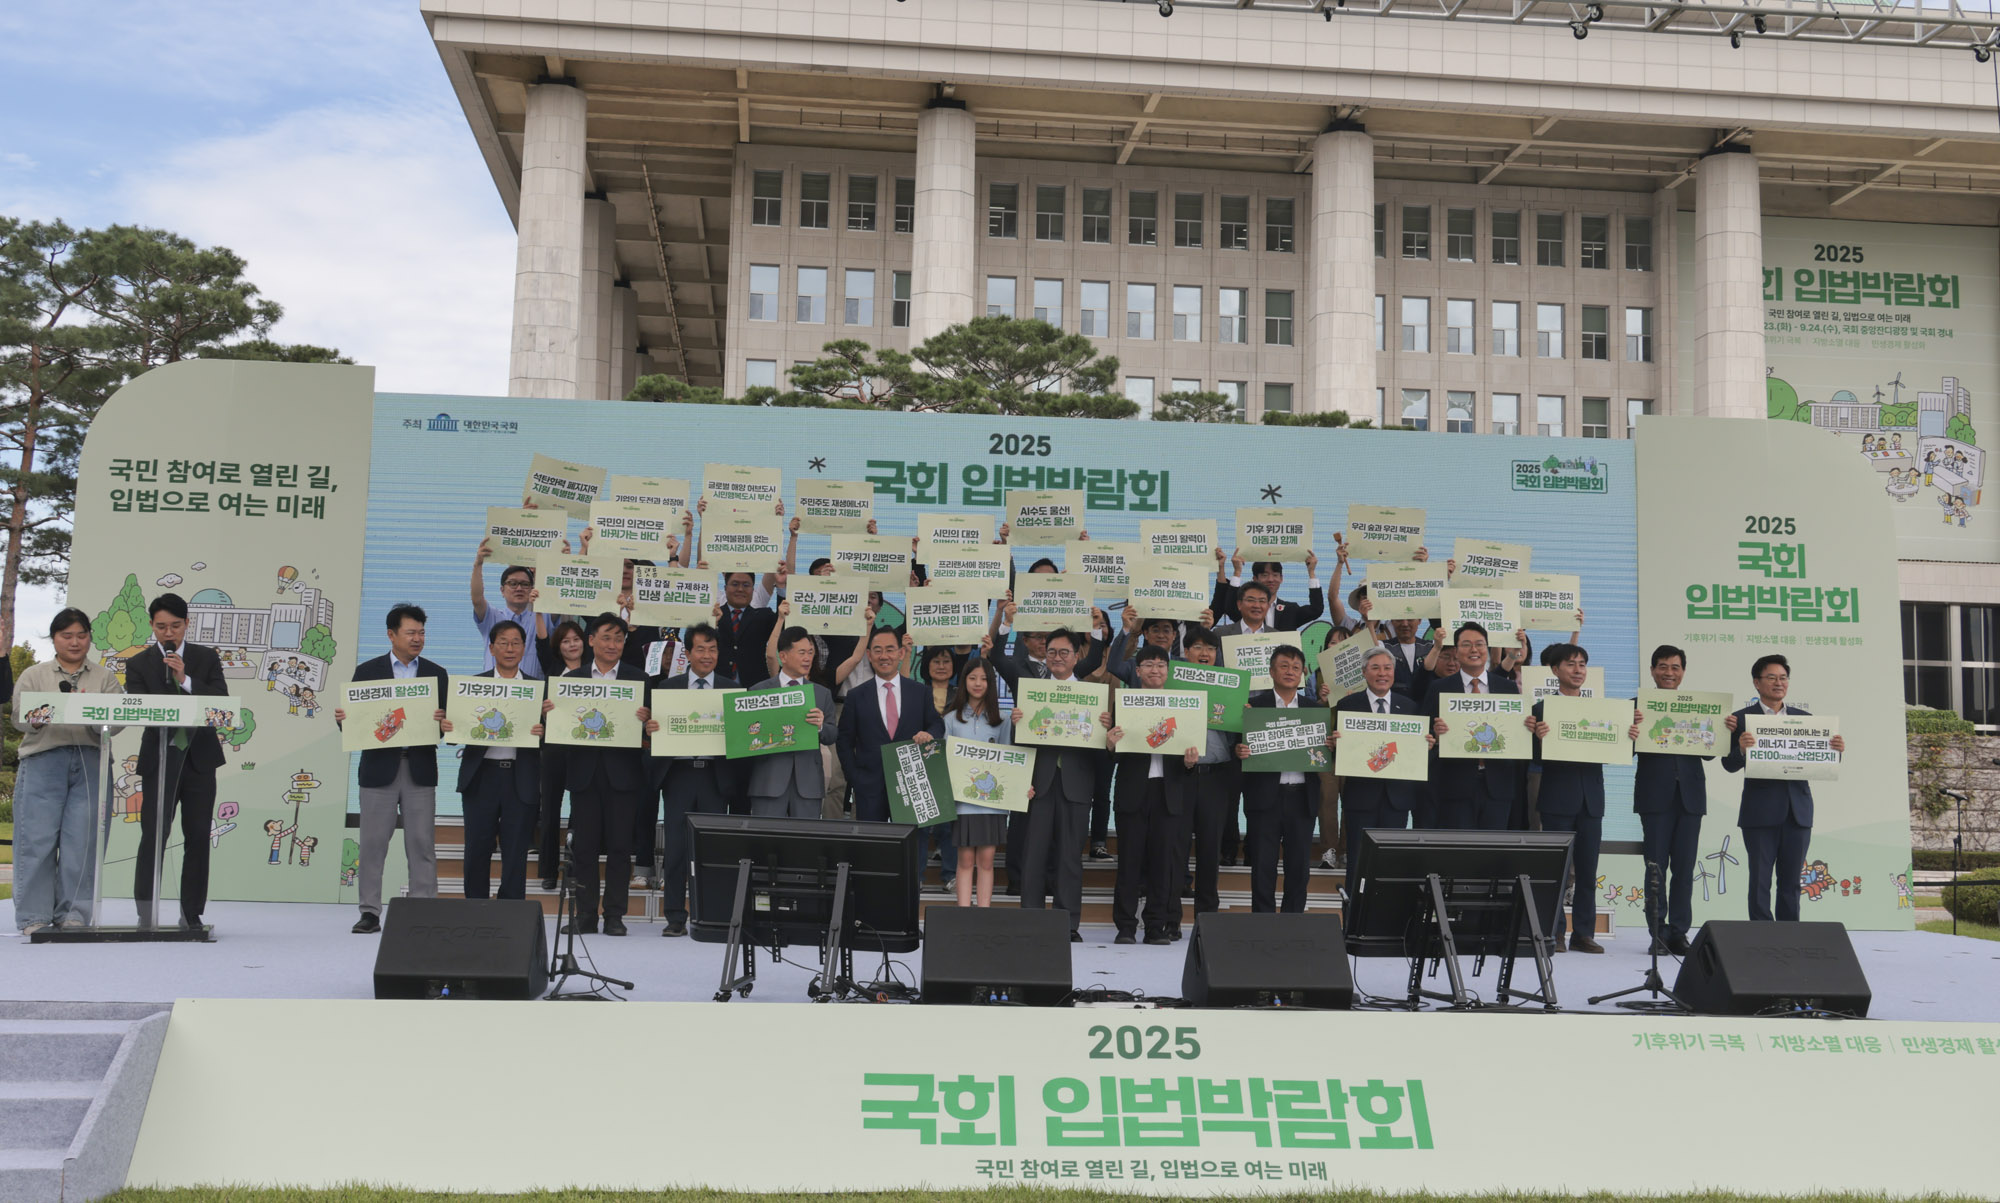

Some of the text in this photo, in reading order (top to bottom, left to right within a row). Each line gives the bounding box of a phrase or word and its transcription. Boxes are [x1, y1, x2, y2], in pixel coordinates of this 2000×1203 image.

[1814, 244, 1864, 263] 2025
[1793, 268, 1960, 309] 입법박람회
[1768, 308, 1911, 324] 국민 참여로 열린 길, 입법으로 여는 미래
[1842, 324, 1859, 336] 국회
[1860, 325, 1908, 337] 중앙잔디광장
[1920, 327, 1936, 338] 국회
[402, 419, 518, 431] 주최 대한민국국회
[988, 433, 1052, 457] 2025
[1516, 464, 1541, 474] 2025
[109, 458, 338, 493] 국민 참여로 열린 길,
[532, 482, 550, 494] 지원
[533, 472, 598, 494] 석탄화력 폐지지역
[864, 459, 948, 505] 국회
[1516, 474, 1604, 490] 국회 입법박람회
[109, 488, 326, 520] 입법으로 여는 미래
[800, 498, 869, 509] 주민주도 재생에너지
[1020, 506, 1071, 516] AI수도 울산!
[597, 517, 664, 530] 국민의 의견으로
[1016, 516, 1075, 526] 산업수도 울산!
[1745, 515, 1796, 535] 2025
[1246, 525, 1303, 534] 기후 위기 대응
[1352, 522, 1397, 533] 우리 숲과 우리
[601, 529, 659, 541] 바꿔가는 바다
[933, 529, 979, 539] 시민의 대화
[1151, 534, 1178, 544] 산촌의
[1252, 535, 1298, 545] 아동과 함께
[1363, 532, 1407, 542] 기후위기 극복
[502, 537, 552, 548] 금융사기OUT
[1163, 545, 1208, 554] 미래입니다
[837, 552, 905, 563] 기후위기 입법으로
[1466, 555, 1519, 570] 기후금융으로
[1738, 541, 1806, 579] 국회
[853, 563, 889, 573] 극복해요!
[938, 560, 977, 569] 프리랜서에
[1084, 565, 1124, 574] 가사서비스
[561, 566, 599, 578] 전북 전주
[1461, 565, 1497, 577] 기후위기
[1099, 575, 1115, 584] 제도
[676, 582, 709, 592] 규제하라
[560, 588, 597, 599] 유치희망
[639, 590, 710, 604] 민생 살리는 길
[794, 592, 858, 604] 군산, 기본사회
[1535, 591, 1574, 600] 바꾸는 정치
[1459, 601, 1503, 610] 함께 만드는
[1535, 600, 1574, 610] 바꾸는 여성
[1686, 583, 1859, 623] 입법박람회
[801, 604, 853, 616] 중심에 서다
[913, 604, 980, 615] 근로기준법 11조
[1460, 611, 1503, 620] 지속가능한
[912, 615, 984, 627] 가사사용인 폐지!
[1684, 633, 1864, 647] 기후위기 극복 지방소멸 대응 민생경제 활성화
[1236, 647, 1262, 657] 지구도
[1174, 667, 1238, 687] 지방소멸 대응
[349, 685, 430, 701] 민생경제 활성화
[458, 682, 535, 699] 기후위기 극복
[558, 684, 633, 699] 기후위기 극복
[122, 698, 143, 706] 2025
[736, 693, 803, 711] 지방소멸 대응
[1027, 691, 1099, 706] 국회 입법박람회
[1123, 696, 1200, 709] 민생경제 활성화
[1449, 699, 1522, 713] 기후위기 극복
[1647, 701, 1721, 715] 국회 입법박람회
[82, 706, 180, 722] 국회 입법박람회
[670, 724, 687, 733] 국회
[1345, 718, 1422, 734] 민생경제 활성화
[1756, 727, 1821, 737] 대한민국이 살아나는
[1248, 723, 1325, 742] 국민 참여로 열린 길
[1560, 730, 1616, 742] 국회 입법박람회
[1250, 735, 1326, 754] 입법으로 여는 미래
[1758, 739, 1828, 750] 에너지 고속도로!
[955, 743, 1026, 765] 기후위기 극복
[1088, 1024, 1201, 1061] 2025
[1632, 1032, 1975, 1055] 기후위기 극복 지방소멸 대응 민생경제
[861, 1072, 1435, 1150] 국회 입법박람회
[975, 1159, 1328, 1182] 국민 참여로 열린 길, 입법으로 여는 미래
